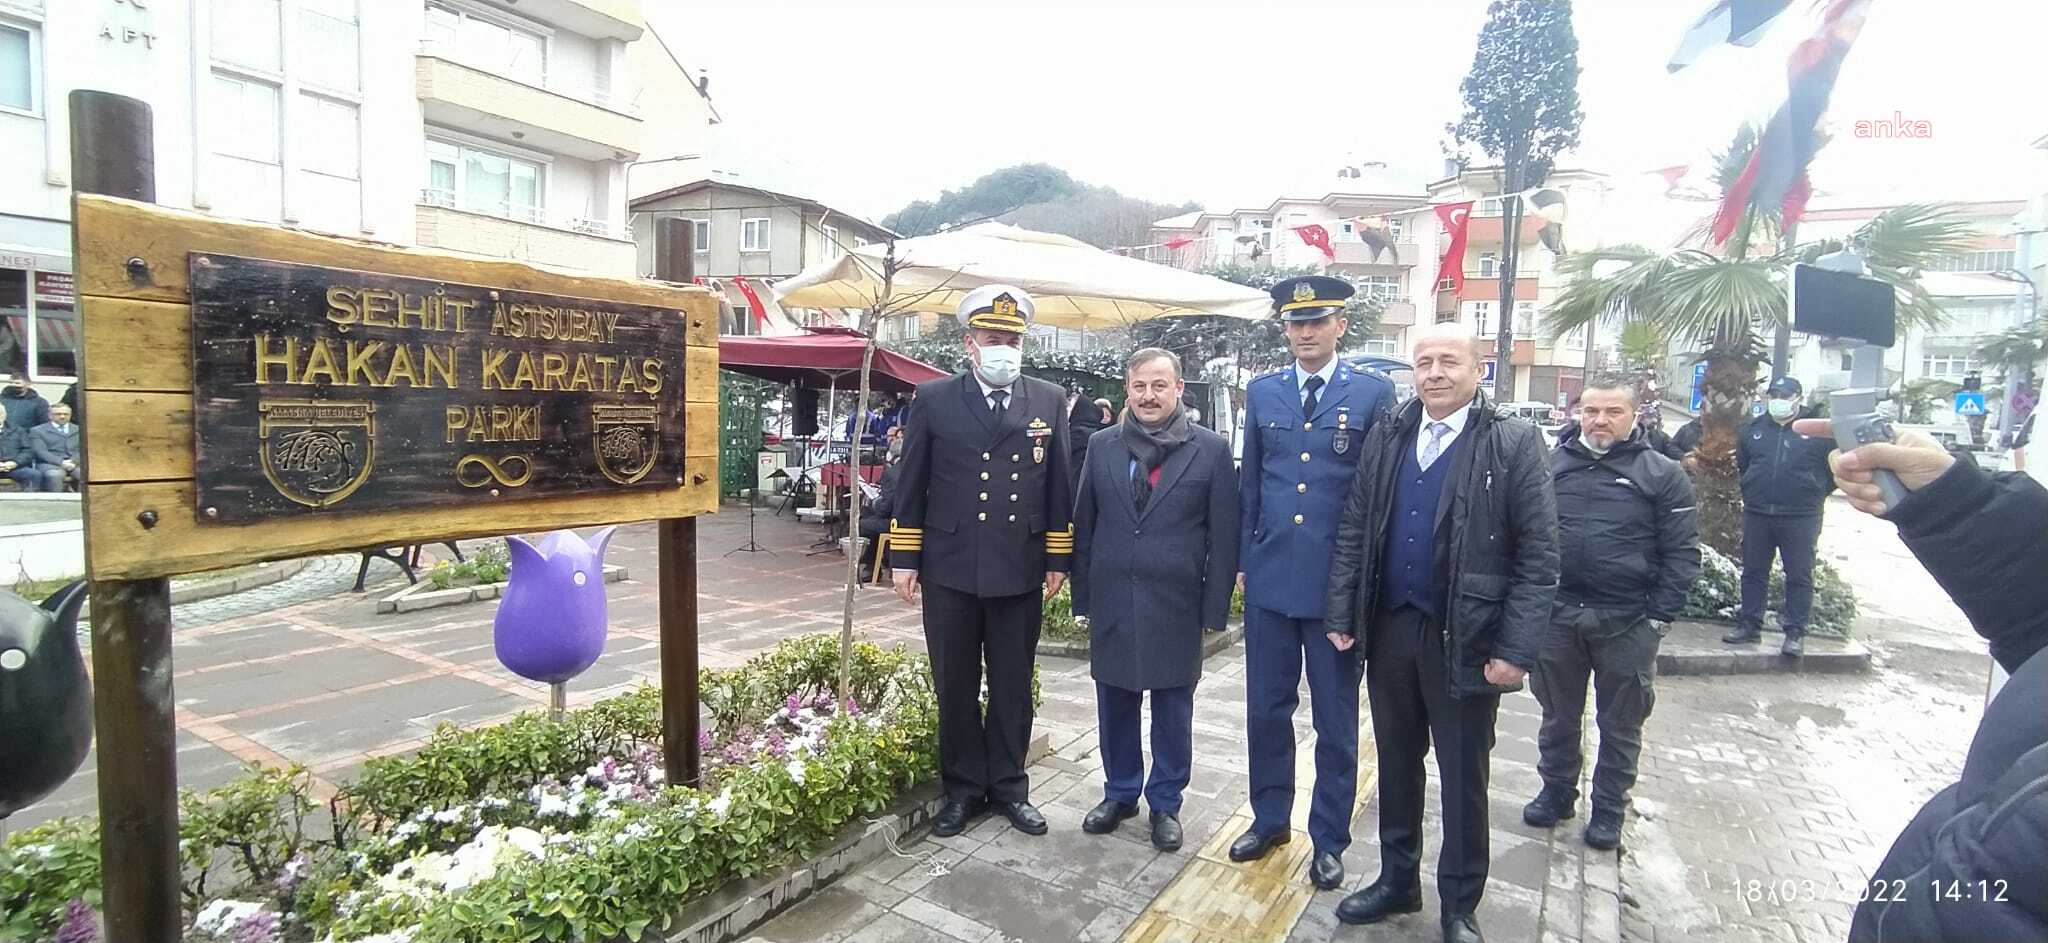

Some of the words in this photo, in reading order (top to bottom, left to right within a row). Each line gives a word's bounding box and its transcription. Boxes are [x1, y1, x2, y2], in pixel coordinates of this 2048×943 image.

[99, 22, 159, 50] APT
[0, 255, 37, 267] NESİ
[326, 284, 474, 333] ŞEHİT
[490, 300, 620, 344] ASTSUBAY
[254, 333, 460, 388] HAKAN
[481, 347, 664, 400] KARATAŞ
[445, 404, 542, 443] PARKI
